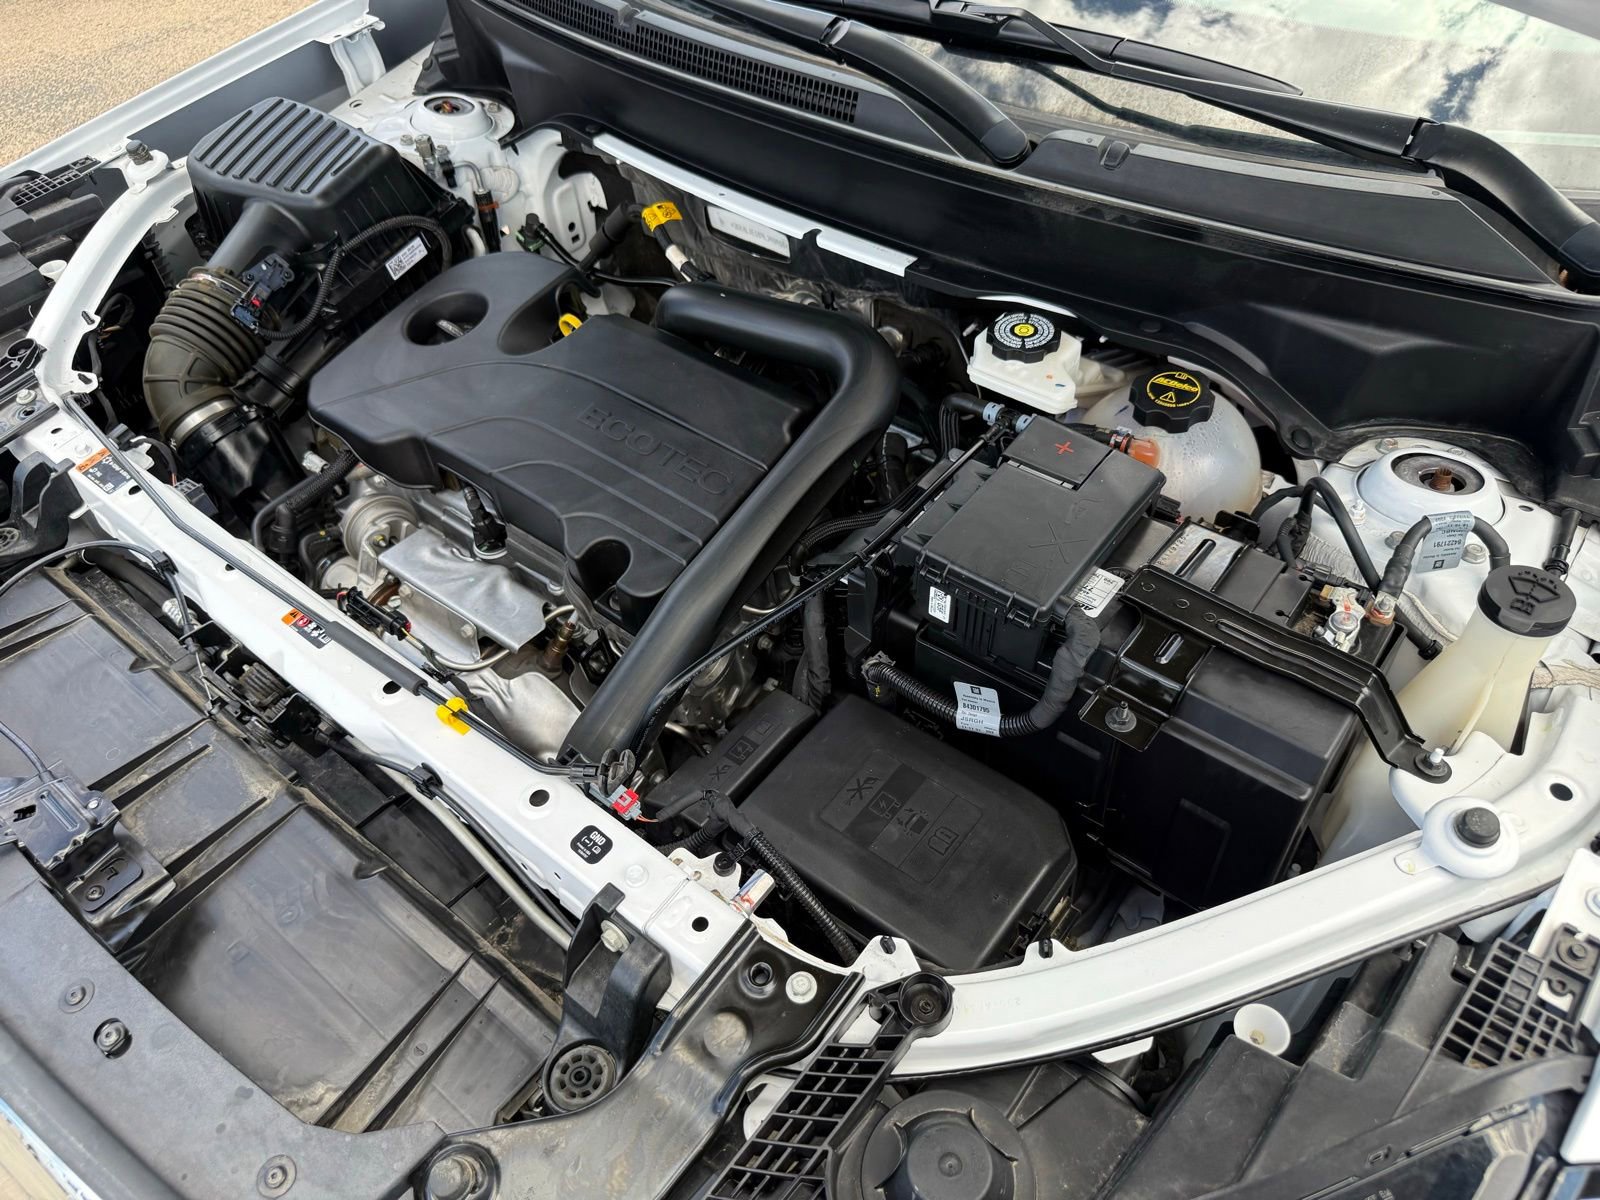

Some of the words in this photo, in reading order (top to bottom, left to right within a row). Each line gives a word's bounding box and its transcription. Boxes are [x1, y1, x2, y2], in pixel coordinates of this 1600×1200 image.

[1152, 377, 1199, 393] ACDelco
[576, 402, 735, 495] ECOTEC
[590, 831, 606, 846] GND
